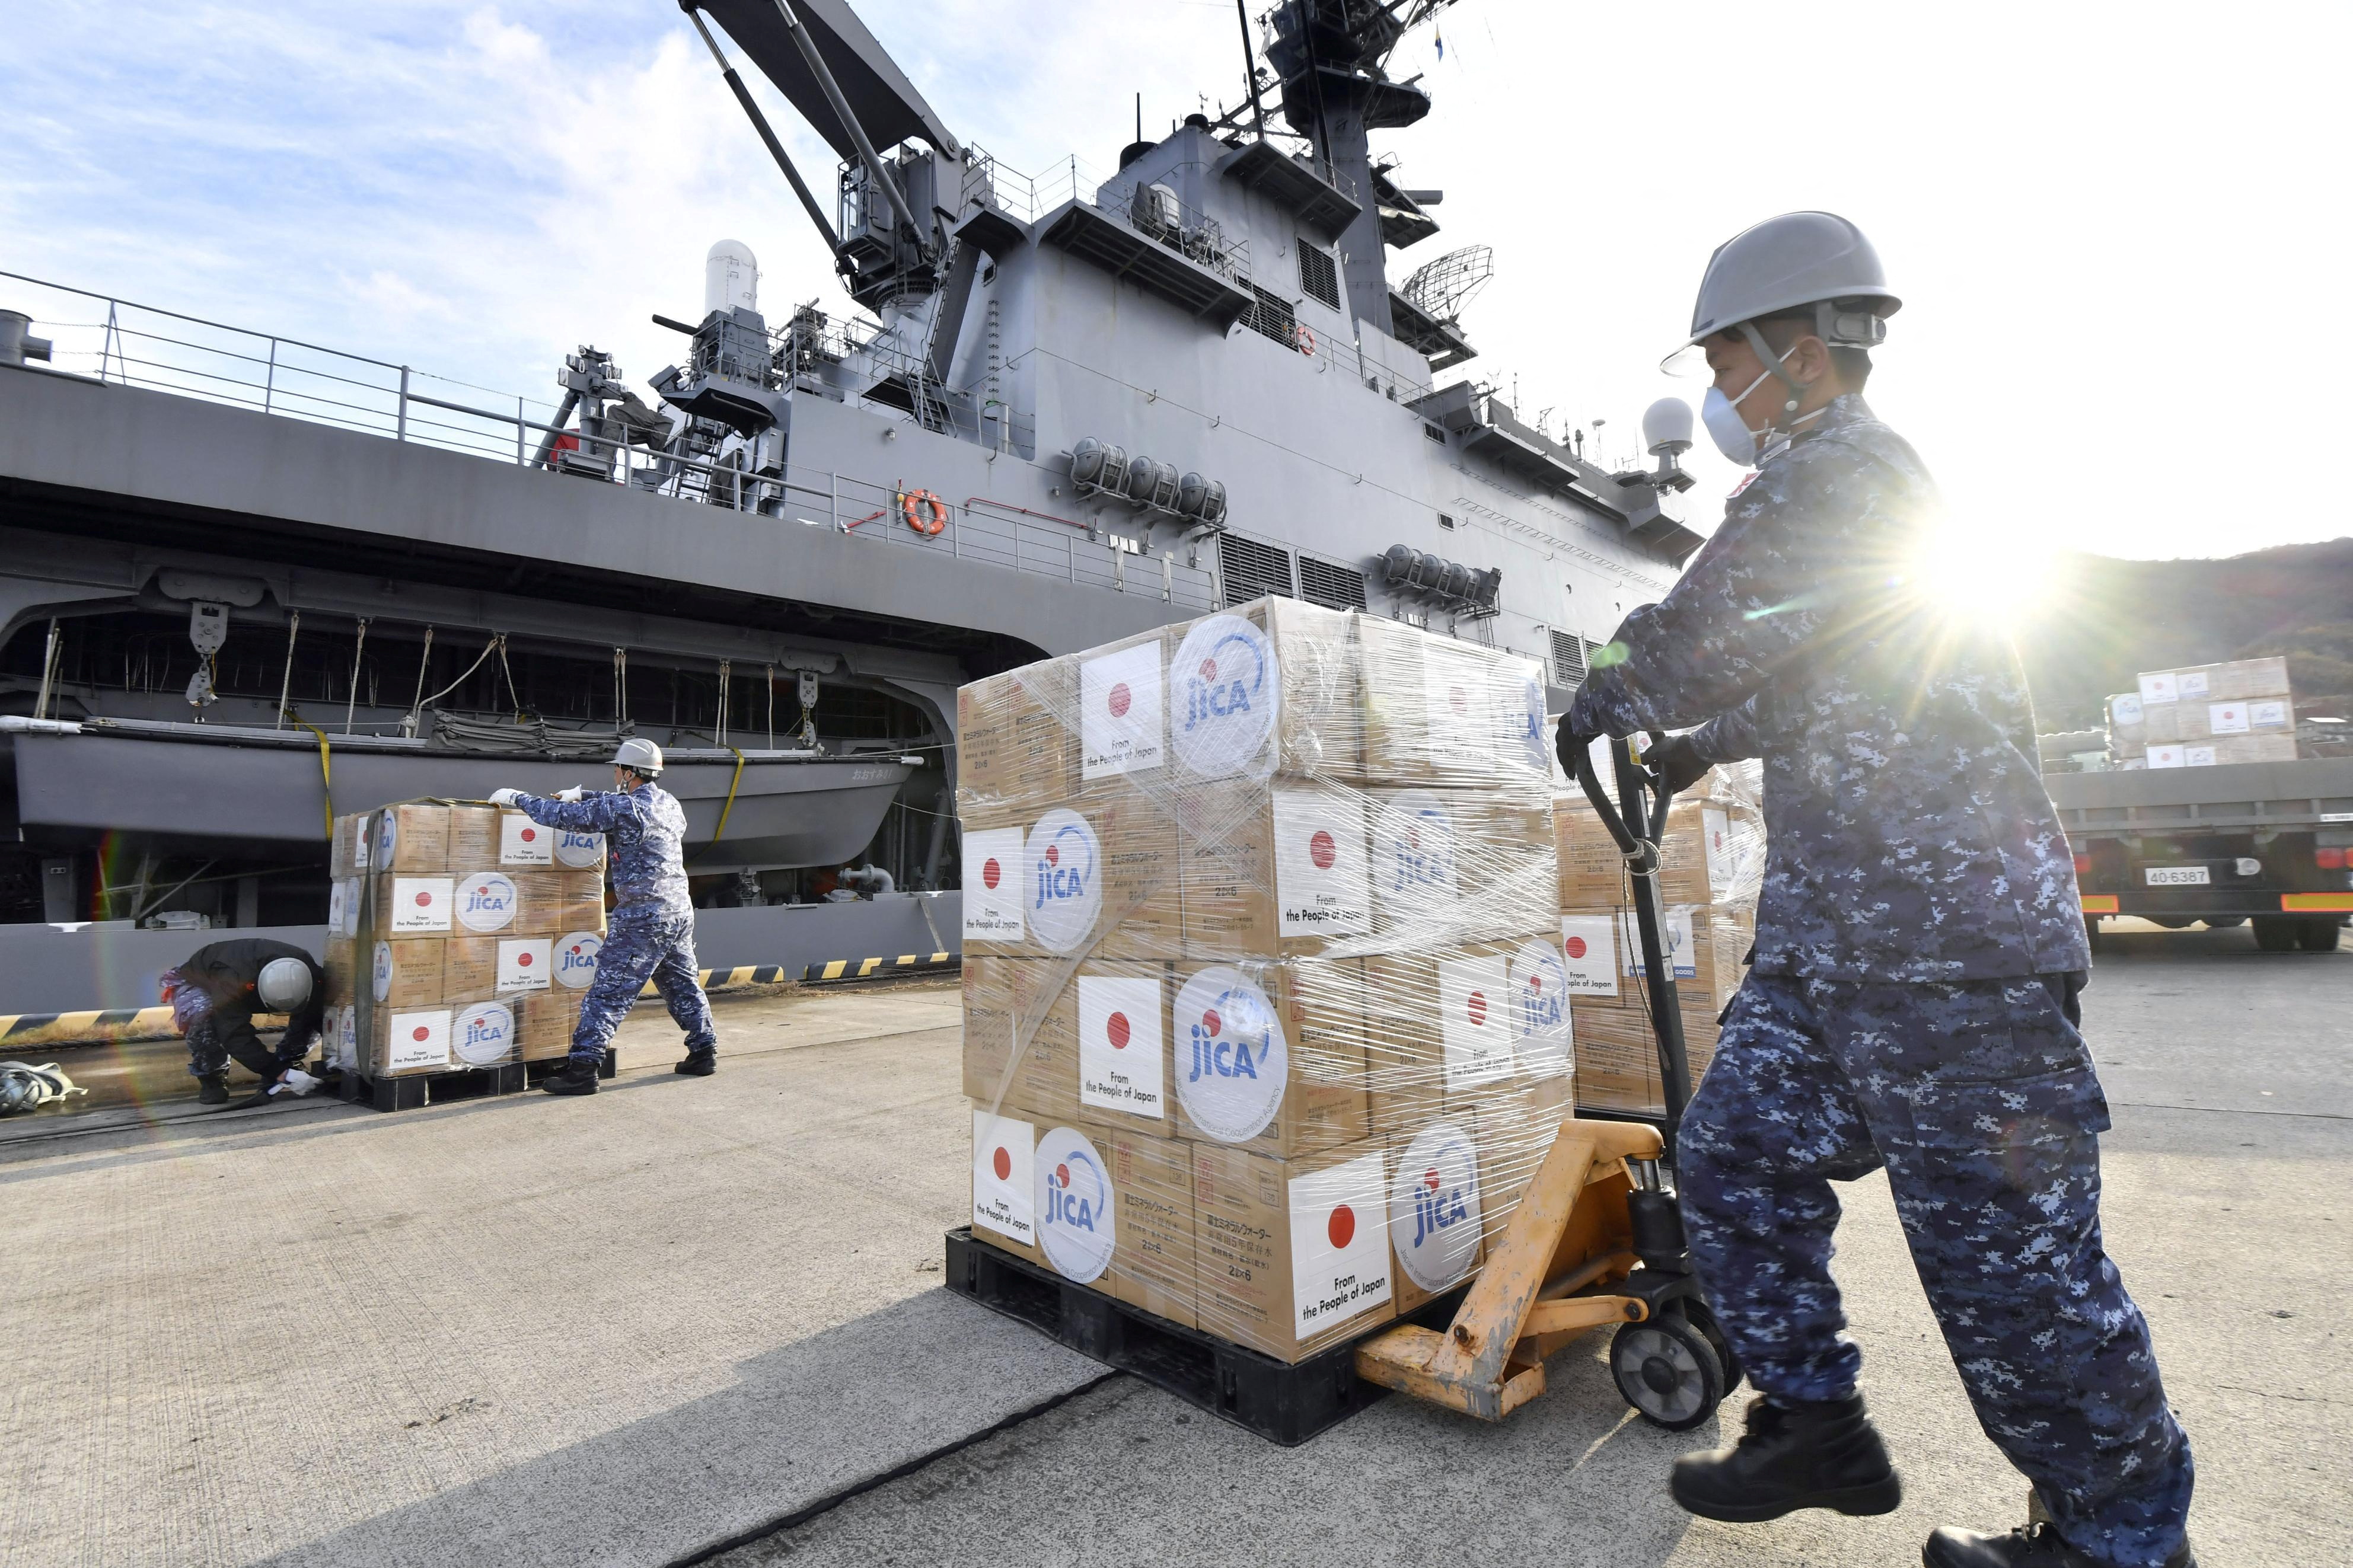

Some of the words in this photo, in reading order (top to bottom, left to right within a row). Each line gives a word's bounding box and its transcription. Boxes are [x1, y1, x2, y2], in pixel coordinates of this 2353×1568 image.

[1111, 740, 1129, 751] From
[1087, 755, 1098, 768] the
[1099, 751, 1123, 766] People
[1124, 749, 1133, 760] of
[1134, 746, 1156, 759] Japan
[2150, 871, 2205, 883] 40-6387
[1316, 894, 1337, 906] From
[985, 908, 999, 917] From
[1286, 908, 1300, 922] the
[1302, 907, 1329, 924] People
[1331, 908, 1340, 920] of
[1343, 909, 1364, 923] Japan
[966, 920, 974, 928] the
[976, 919, 993, 931] People
[994, 920, 1000, 928] of
[1002, 920, 1019, 931] Japan
[1590, 981, 1612, 989] Japan
[1111, 1071, 1128, 1084] From
[1086, 1080, 1096, 1093] the
[1098, 1082, 1122, 1099] People
[1124, 1087, 1132, 1098] of
[1133, 1091, 1157, 1104] Japan
[995, 1198, 1009, 1212] From
[977, 1203, 985, 1215] the
[986, 1206, 1004, 1223] People
[1005, 1213, 1011, 1224] of
[1012, 1218, 1030, 1232] Japan
[1401, 1248, 1414, 1272] Japan
[1334, 1275, 1356, 1291] From
[1303, 1305, 1317, 1321] the
[1319, 1291, 1348, 1314] People
[1351, 1284, 1359, 1299] of
[1362, 1277, 1385, 1295] Japan
